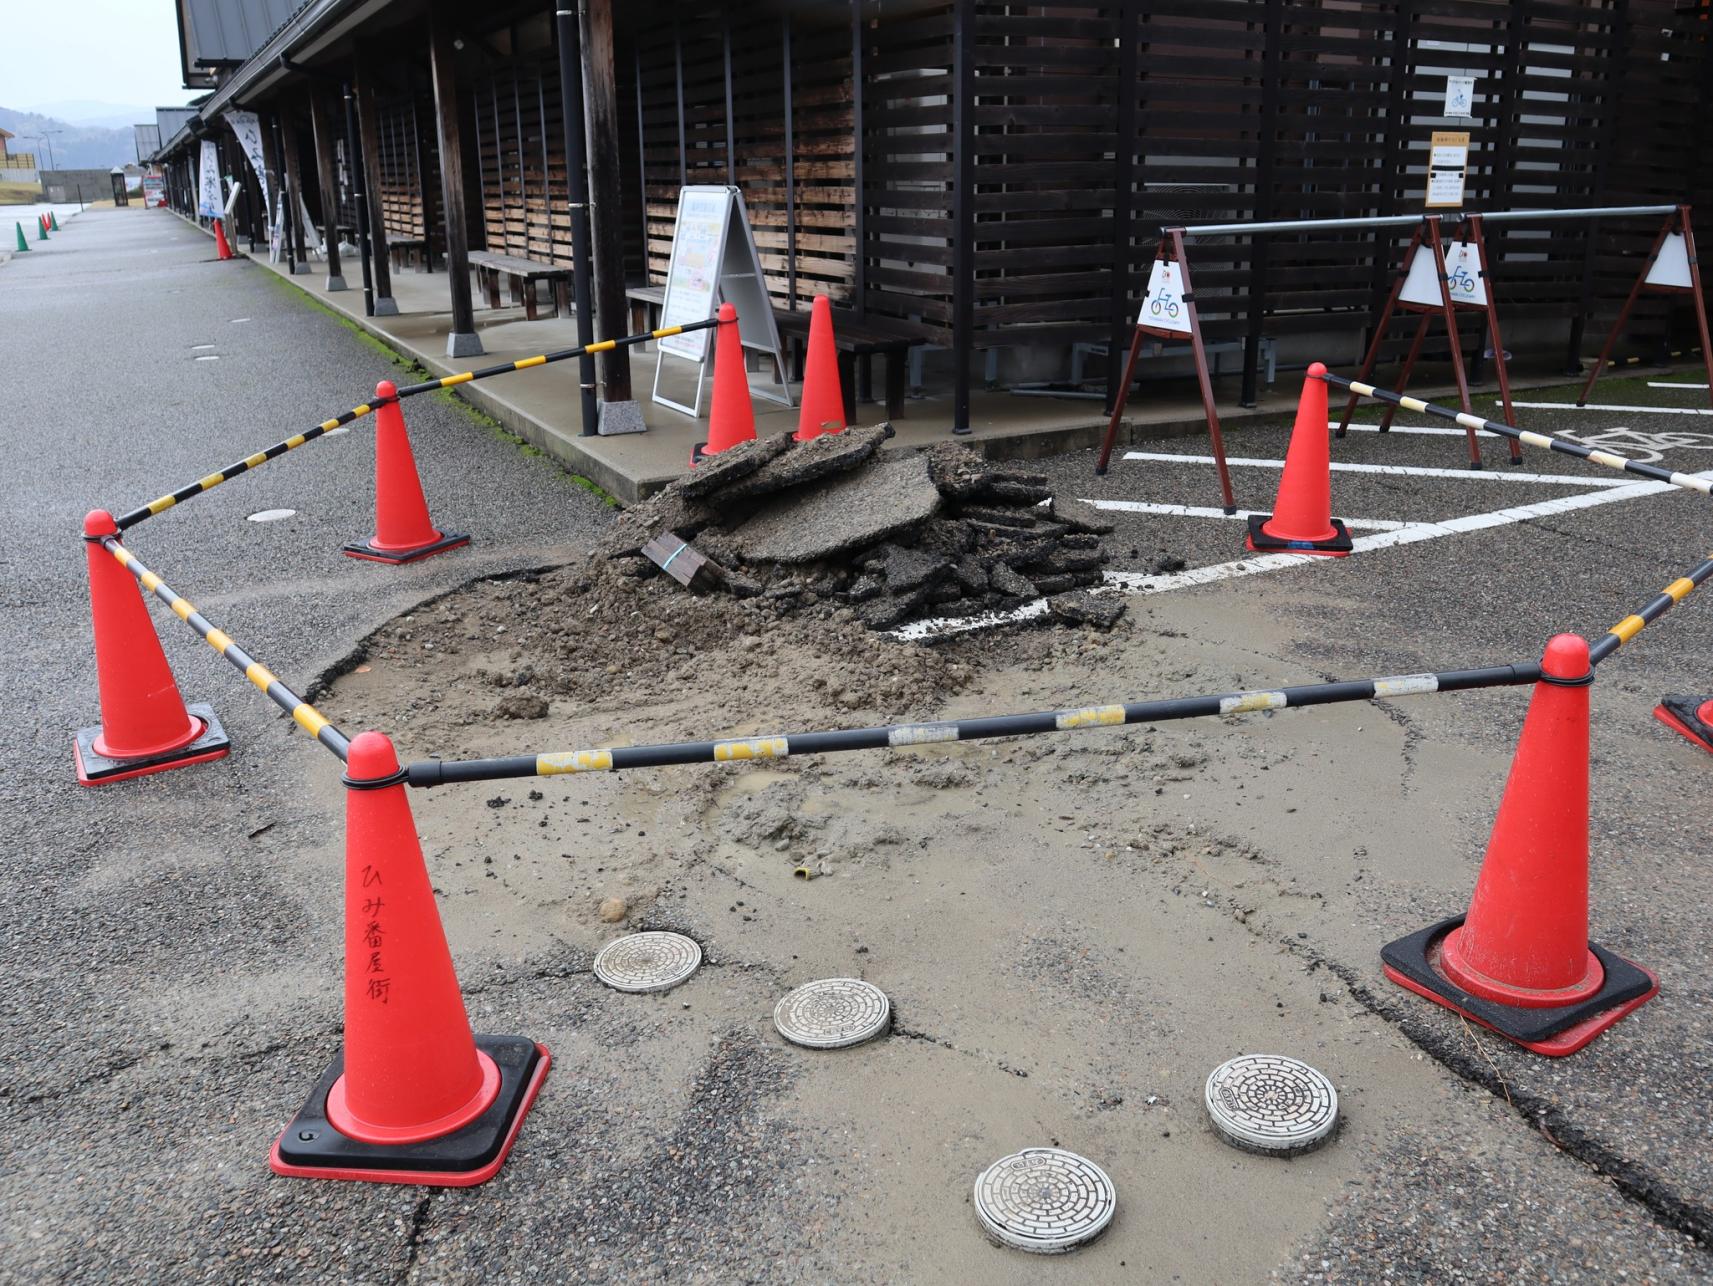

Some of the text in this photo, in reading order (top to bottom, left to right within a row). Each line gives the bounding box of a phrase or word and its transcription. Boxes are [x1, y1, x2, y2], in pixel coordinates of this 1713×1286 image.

[361, 864, 391, 1004] ひみ番屋街
